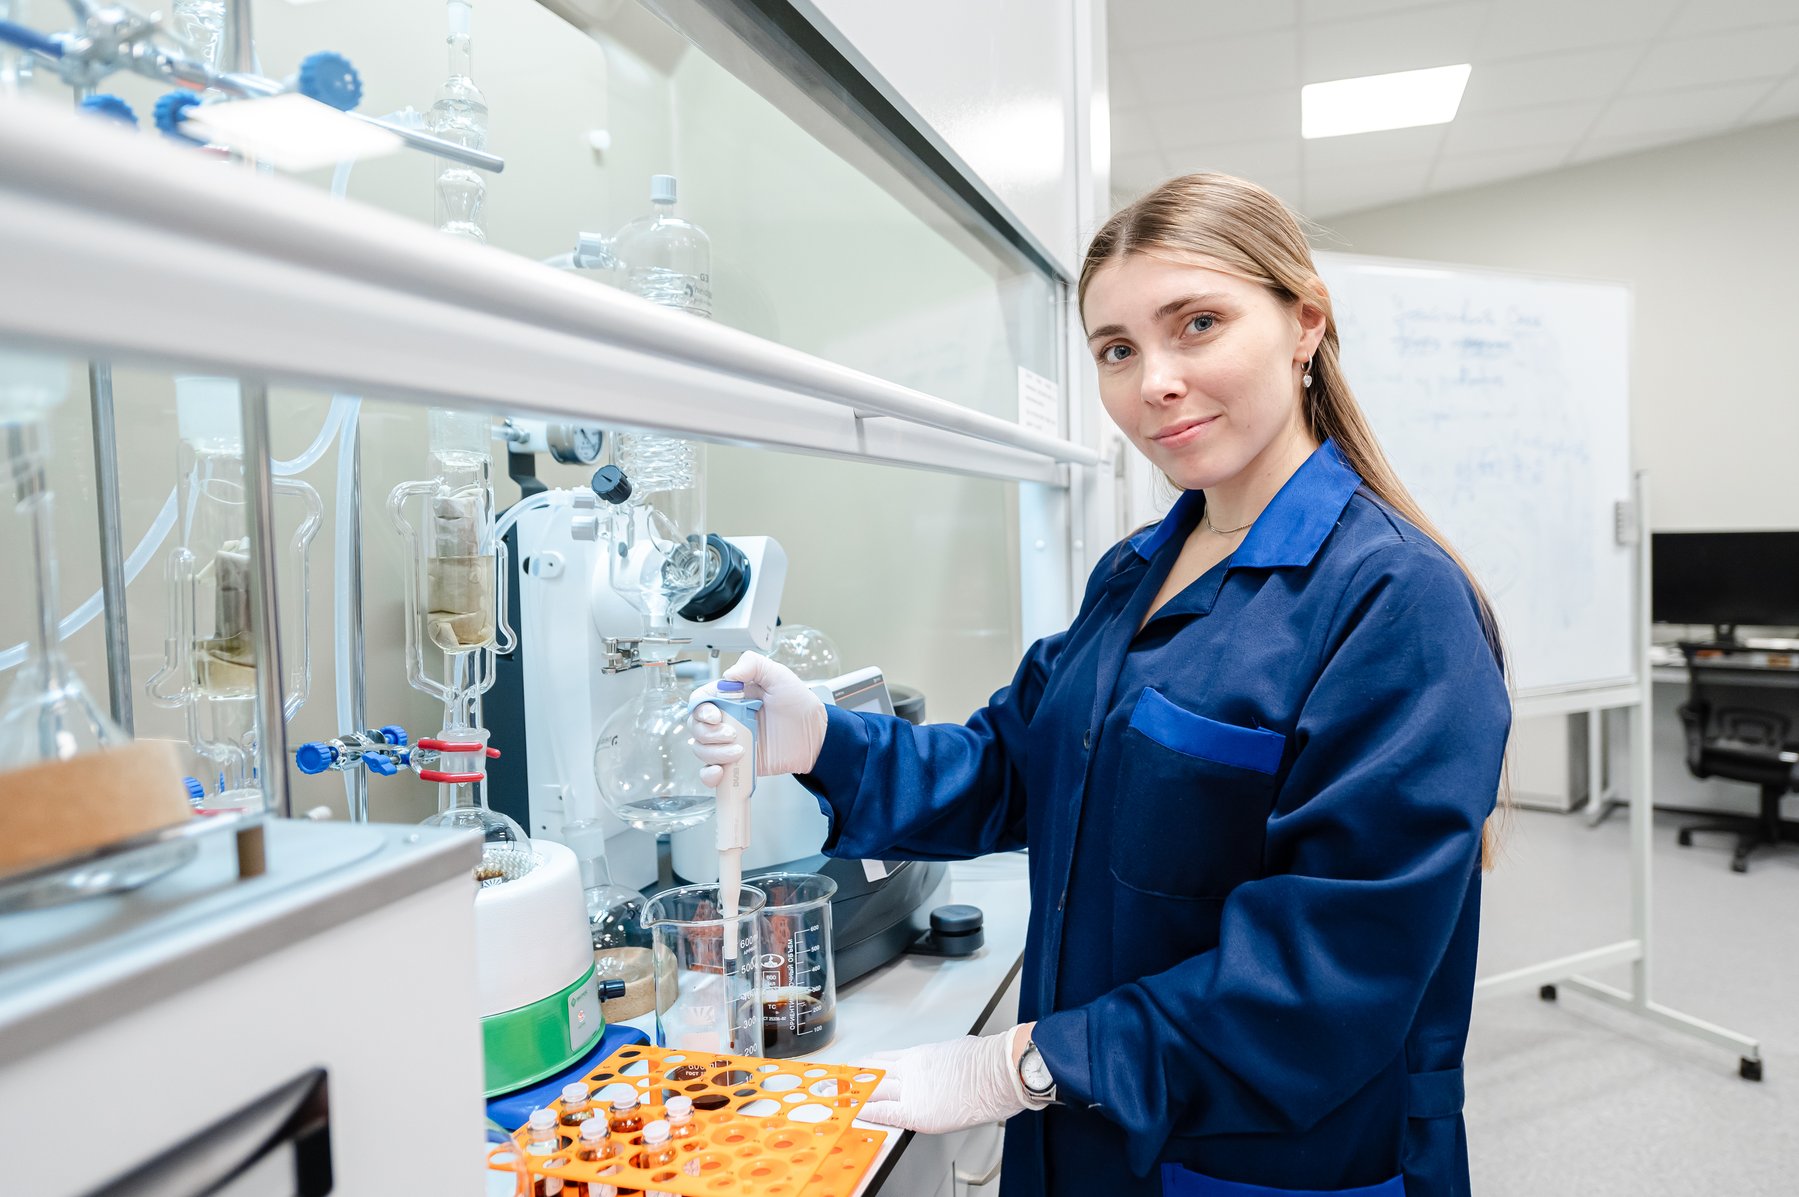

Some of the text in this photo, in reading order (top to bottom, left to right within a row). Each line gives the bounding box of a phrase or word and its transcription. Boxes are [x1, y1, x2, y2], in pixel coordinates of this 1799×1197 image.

[810, 924, 820, 932] 600
[811, 944, 820, 953] 500
[812, 985, 822, 993] 300
[787, 964, 796, 1031] ОРИЕНТИОЧНЫЙ
[812, 1005, 822, 1013] 200
[743, 1015, 757, 1029] 300
[813, 1025, 823, 1033] 100
[744, 1042, 758, 1056] 200
